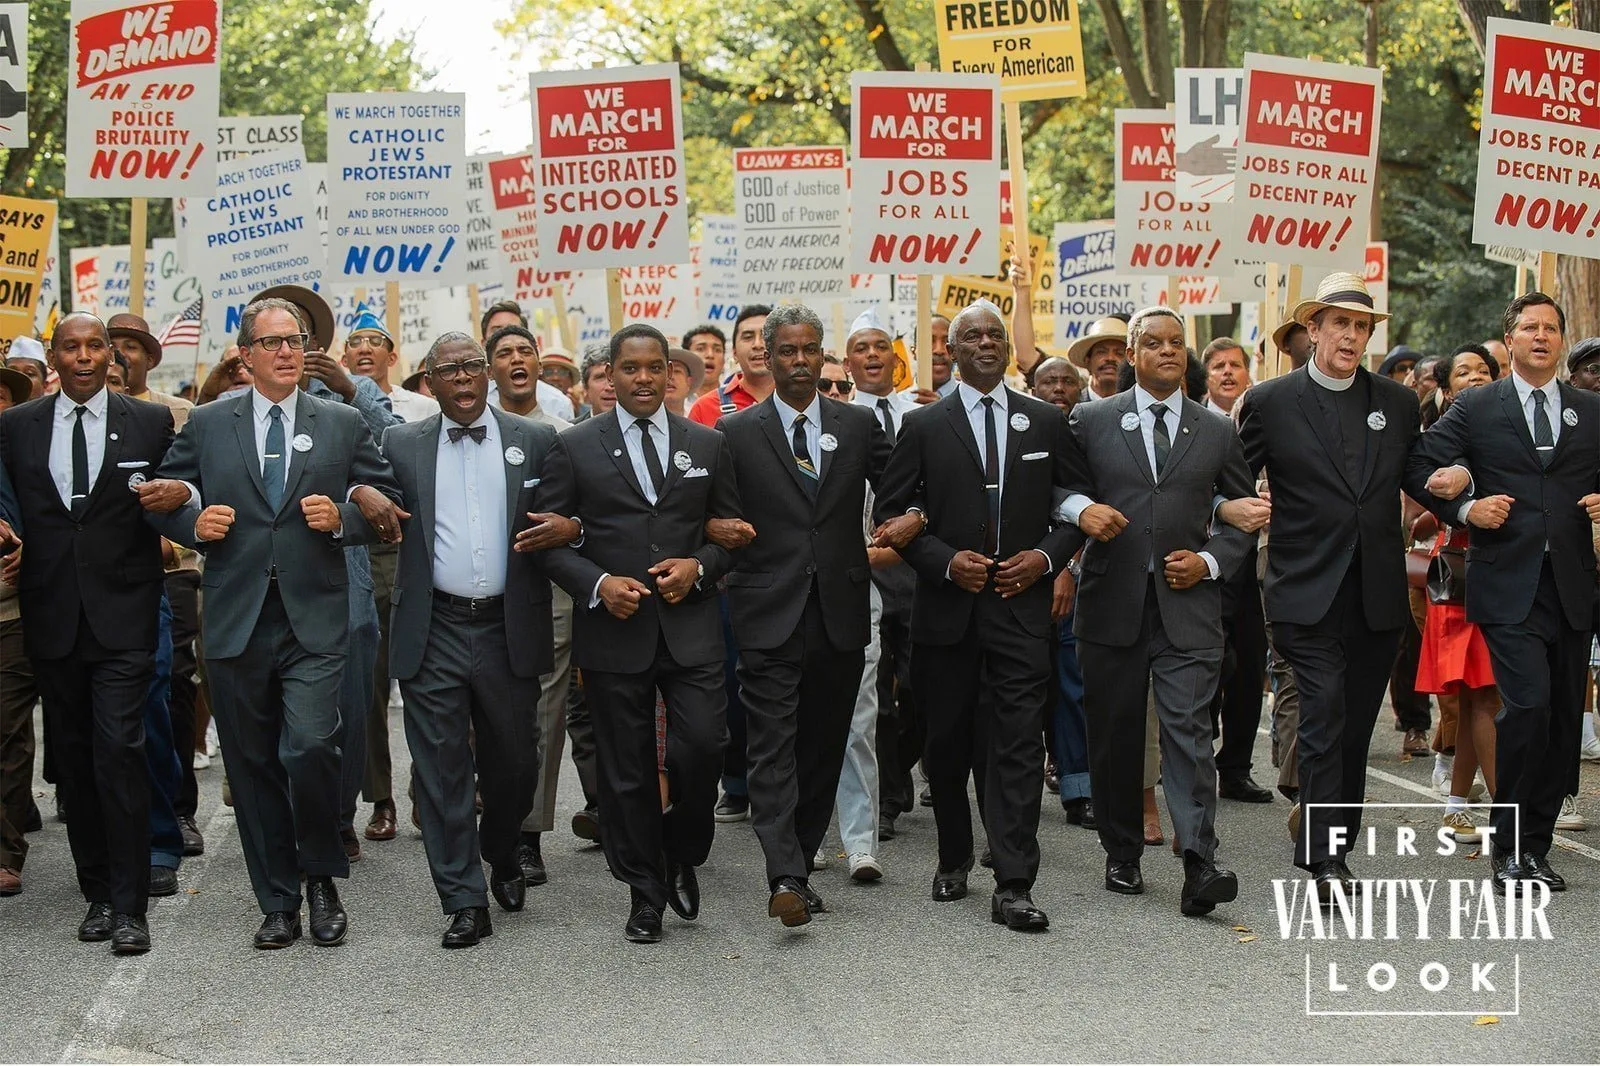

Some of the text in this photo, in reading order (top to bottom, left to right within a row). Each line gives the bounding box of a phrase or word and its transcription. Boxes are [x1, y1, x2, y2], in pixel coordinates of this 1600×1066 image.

[121, 5, 174, 39] WE
[945, 0, 1071, 31] FREEDOM
[84, 26, 211, 78] DEMAND
[993, 37, 1032, 53] FOR
[1001, 52, 1075, 78] American
[1544, 48, 1585, 75] WE
[90, 83, 195, 100] AN END
[584, 87, 625, 109] WE
[1295, 80, 1332, 105] WE
[131, 102, 153, 110] TO
[334, 105, 461, 119] WE MARCH TOGETHER
[907, 92, 947, 114] WE
[1541, 103, 1581, 123] FOR
[112, 111, 174, 126] POLICE
[550, 107, 663, 138] MARCH
[870, 115, 982, 140] MARCH
[1256, 100, 1362, 136] MARCH
[96, 130, 189, 145] BRUTALITY
[247, 126, 298, 144] CLASS
[349, 128, 445, 144] CATHOLIC
[587, 136, 628, 152] FOR
[1290, 130, 1328, 149] FOR
[1488, 128, 1541, 151] JOBS
[1548, 136, 1587, 158] FOR
[369, 147, 425, 162] JEWS
[907, 142, 947, 156] FOR
[1130, 145, 1176, 166] MA
[90, 143, 204, 180] NOW!
[541, 155, 677, 186] INTEGRATED
[741, 153, 840, 169] UAW SAYS:
[1242, 156, 1368, 185] JOBS FOR ALL
[1496, 158, 1573, 185] DECENT
[217, 159, 302, 187] ARCH TOGETHER
[343, 165, 451, 181] PROTESTANT
[881, 169, 968, 197] JOBS
[207, 183, 292, 212] CATHOLIC
[366, 190, 430, 201] FOR DIGNITY
[742, 176, 841, 198] GOD of Justice
[1249, 182, 1357, 210] DECENT PAY
[544, 185, 678, 214] SCHOOLS
[229, 204, 278, 226] JEWS
[348, 207, 448, 219] AND BROTHERHOOD
[745, 202, 840, 224] GOD of Power
[880, 204, 970, 219] FOR ALL
[207, 216, 304, 247] PROTESTANT
[336, 224, 460, 237] OF ALL MEN UNDER GOD
[557, 211, 669, 254] NOW!
[1138, 219, 1212, 232] FOR ALL
[1247, 213, 1353, 252] NOW!
[745, 234, 840, 250] CAN AMERICA
[869, 227, 981, 264] NOW!
[1083, 231, 1115, 254] WE
[1130, 238, 1221, 268] NOW!
[6, 249, 39, 268] and
[232, 244, 290, 263] FOR DIGNITY
[343, 236, 456, 274] NOW!
[510, 254, 529, 263] ALL
[743, 256, 845, 273] DENY FREEDOM
[219, 256, 309, 281] AND BROTHERHOOD
[639, 265, 678, 279] FEPC
[212, 288, 224, 299] OF
[227, 286, 244, 297] ALL
[247, 280, 267, 293] MEN
[269, 274, 299, 287] UNDER
[302, 270, 322, 281] GOD
[623, 282, 662, 296] LAW
[747, 281, 762, 295] IN
[767, 280, 795, 295] THIS
[799, 279, 843, 294] HOUR?
[1066, 284, 1131, 298] DECENT
[1060, 301, 1135, 316] HOUSING
